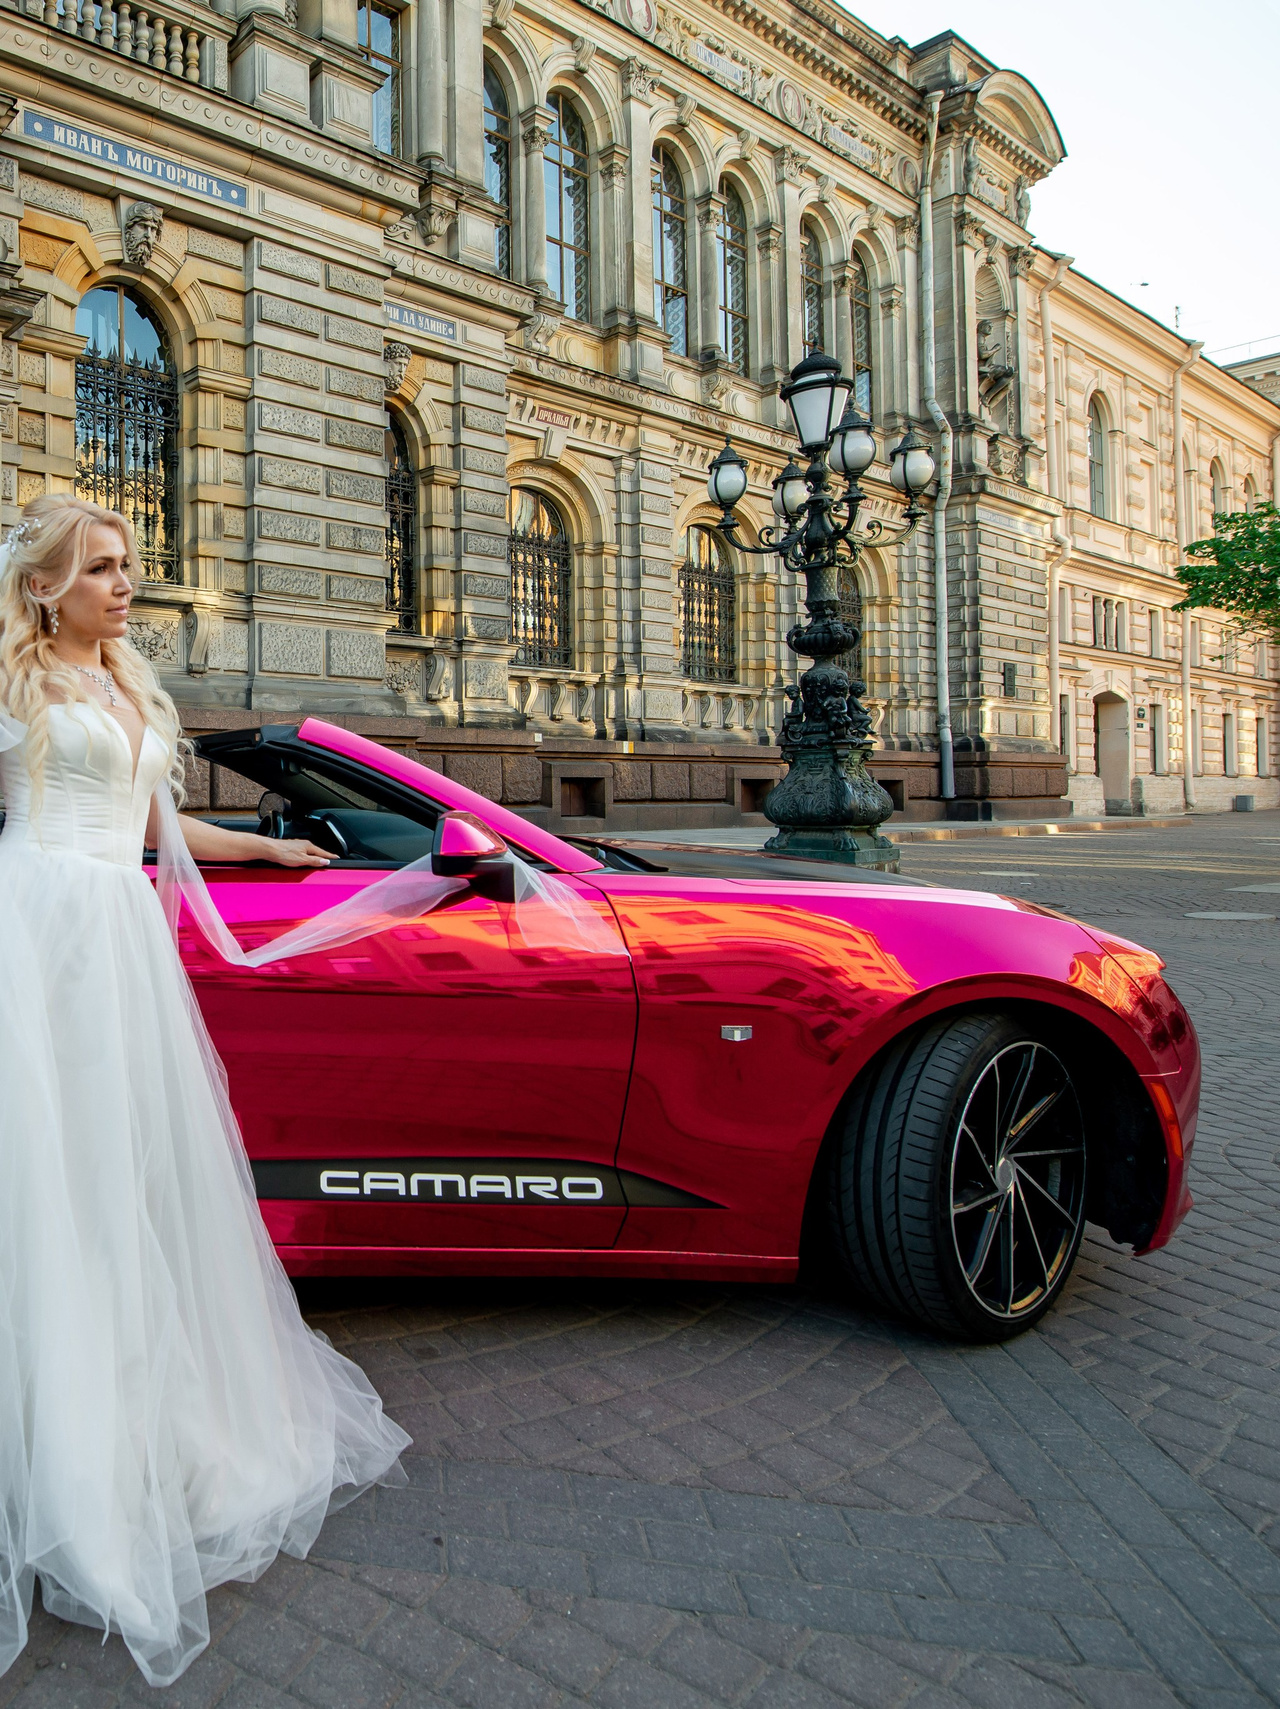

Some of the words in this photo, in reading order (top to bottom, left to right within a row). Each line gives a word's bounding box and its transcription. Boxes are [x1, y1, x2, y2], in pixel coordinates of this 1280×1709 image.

[53, 124, 118, 162] ИВАНЪ
[126, 149, 222, 198] МОТОРИНЪ
[383, 304, 399, 321] ЧИ
[402, 311, 415, 326] ДА
[418, 315, 448, 336] УДИНЕ
[538, 409, 569, 427] ОРКАНЬЯ
[320, 1169, 604, 1200] CAMARO
